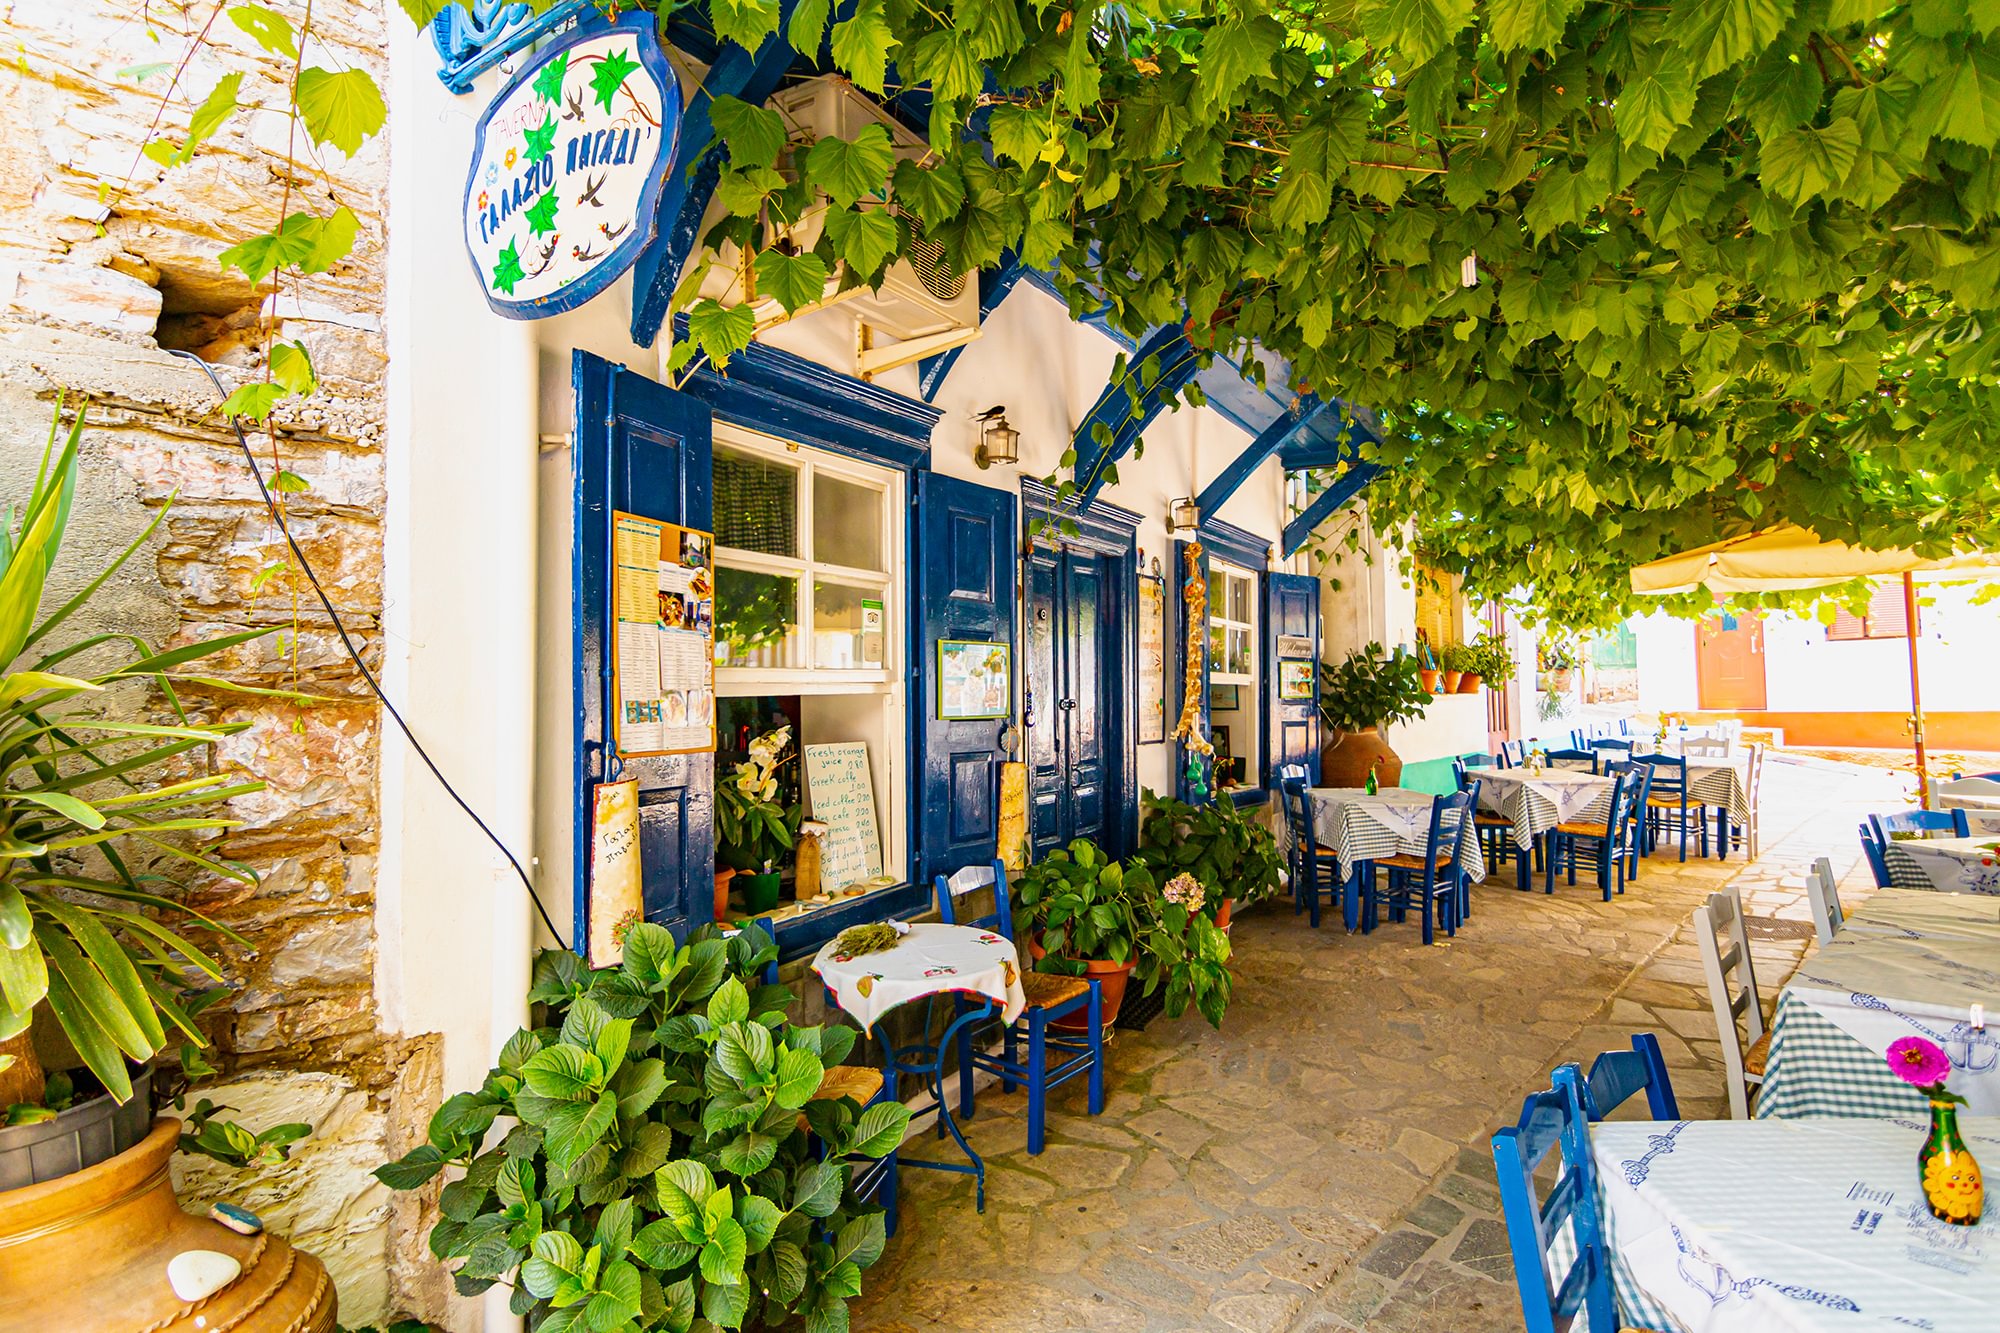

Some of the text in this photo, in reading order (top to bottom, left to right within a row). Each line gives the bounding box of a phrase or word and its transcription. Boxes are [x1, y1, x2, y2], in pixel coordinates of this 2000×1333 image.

[493, 94, 547, 144] TAVERNA
[1280, 641, 1312, 656] Welcome
[807, 746, 865, 758] Fresh orange
[821, 759, 842, 768] juice
[813, 796, 830, 809] Iced
[833, 794, 855, 806] coffee
[827, 826, 850, 838] presso
[827, 837, 857, 849] ppuccino
